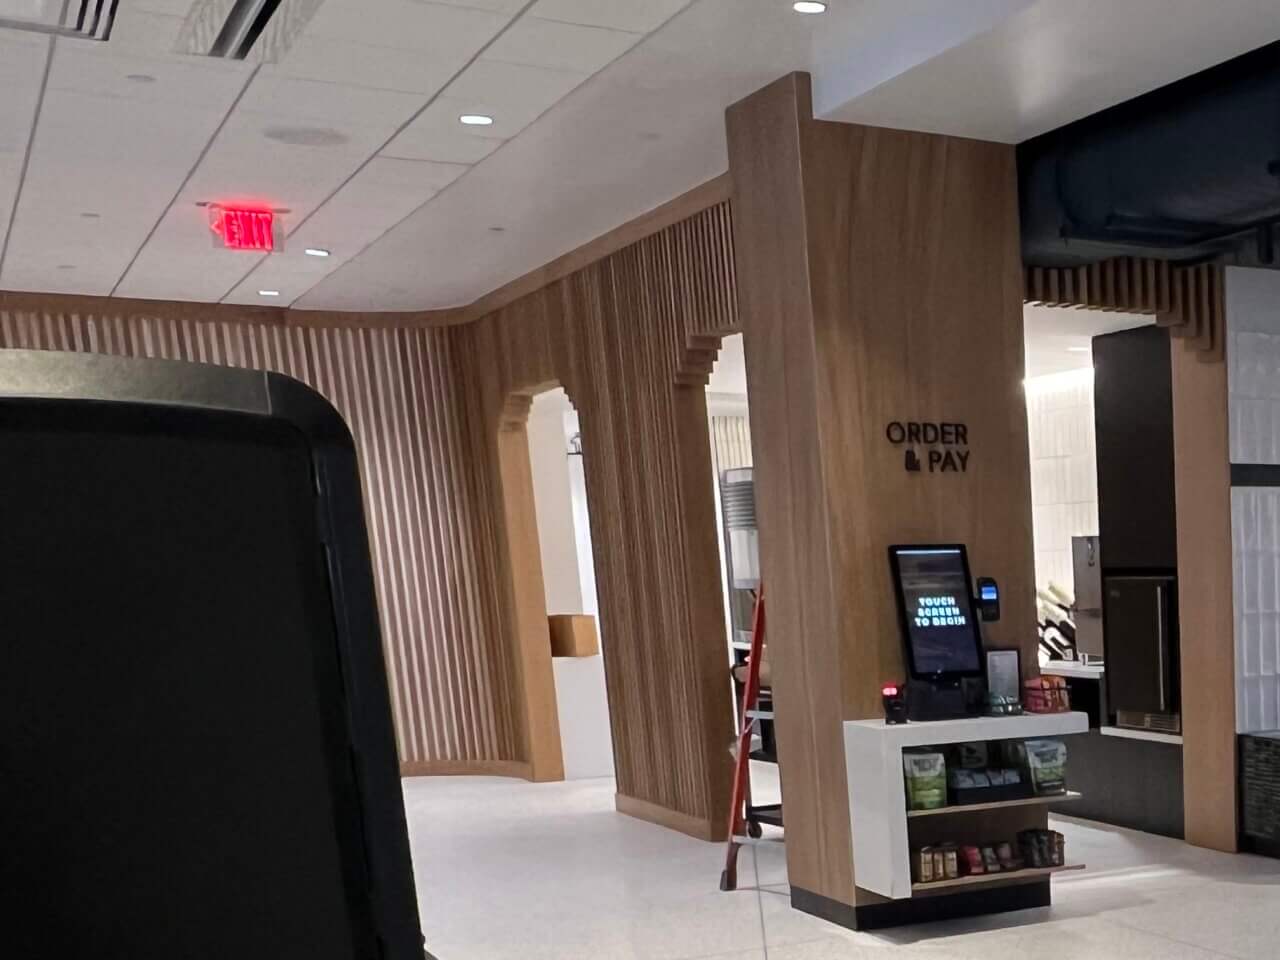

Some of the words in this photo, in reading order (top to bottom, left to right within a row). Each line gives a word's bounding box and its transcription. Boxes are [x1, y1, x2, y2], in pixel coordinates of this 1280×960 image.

[224, 211, 272, 250] EXIT
[886, 421, 968, 445] ORDER
[928, 450, 970, 472] PAY
[918, 596, 955, 606] TOUCH
[914, 617, 930, 626] TO
